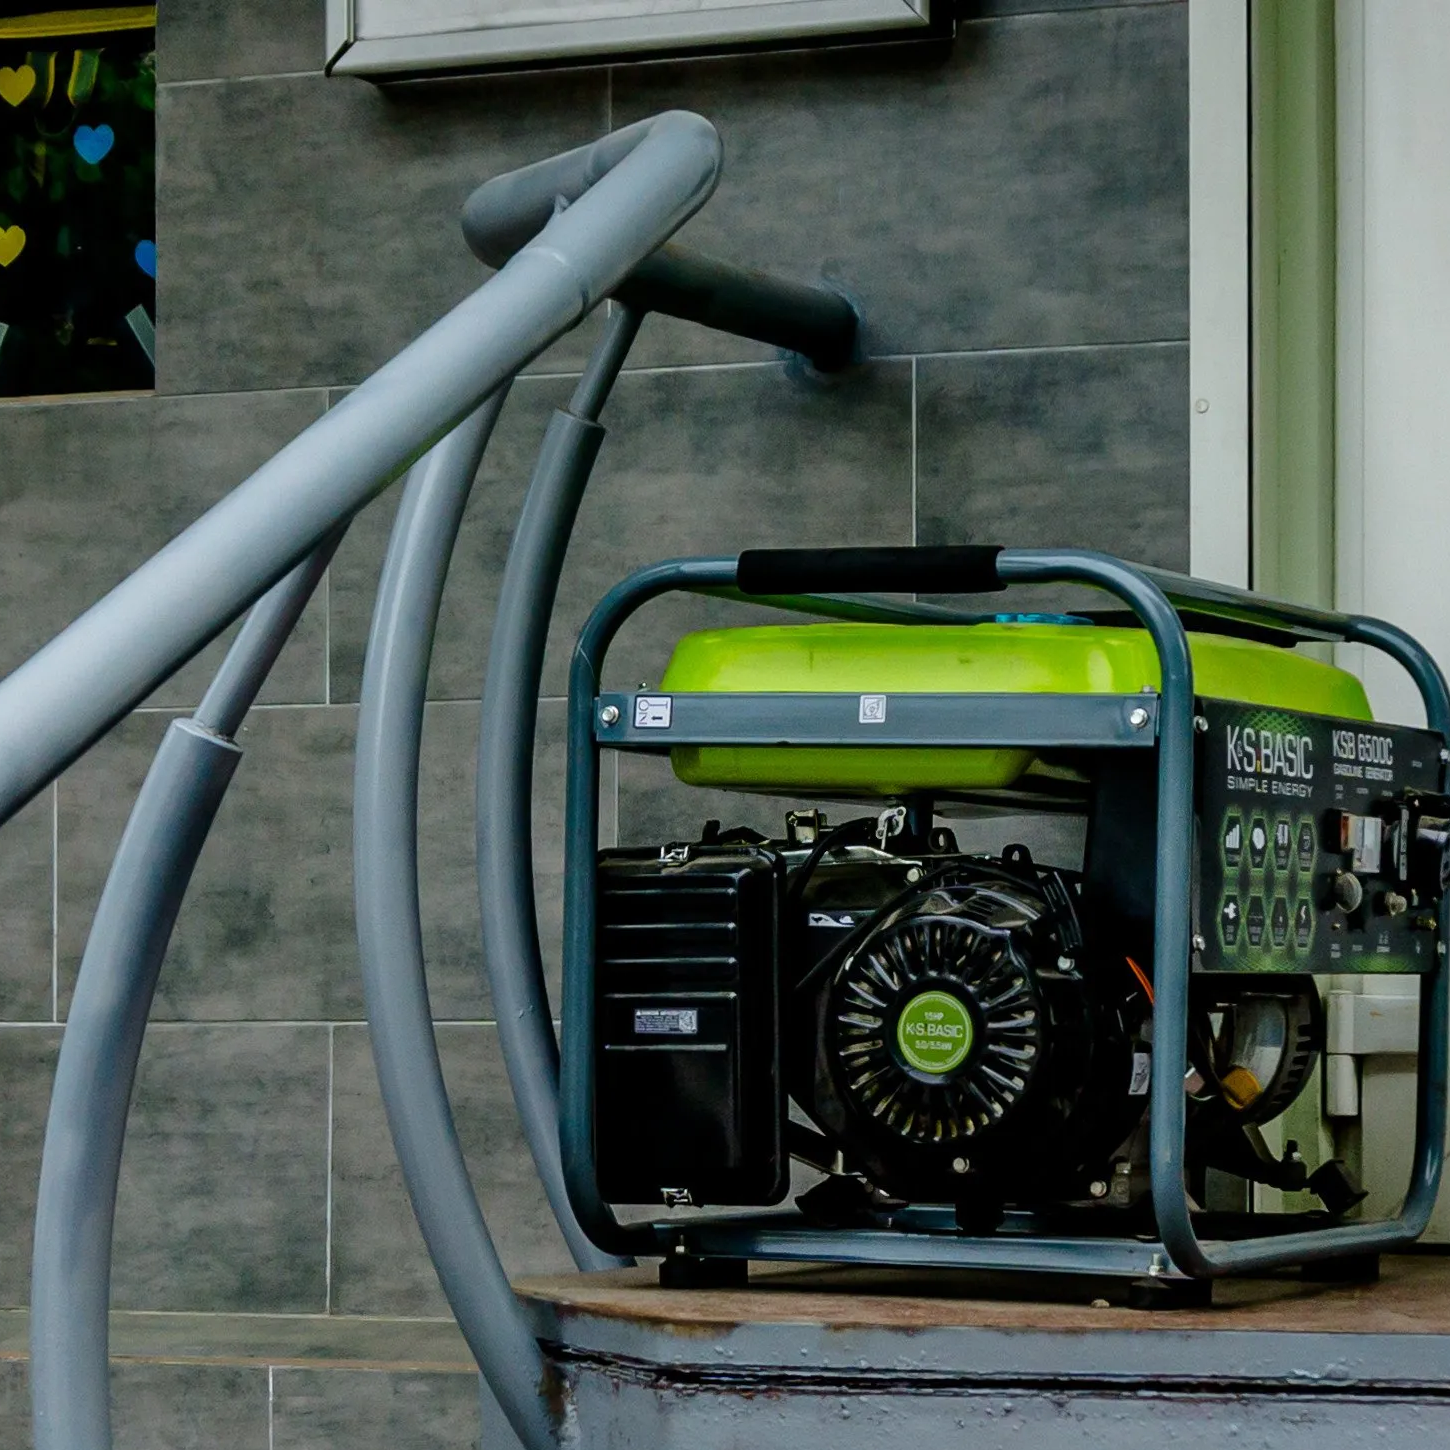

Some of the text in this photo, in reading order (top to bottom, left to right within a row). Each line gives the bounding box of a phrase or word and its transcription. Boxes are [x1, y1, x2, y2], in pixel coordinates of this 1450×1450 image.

[1260, 729, 1314, 779] BASIC
[1332, 730, 1393, 765] KSB 6500C
[1227, 775, 1313, 798] SIMPLE ENERGY
